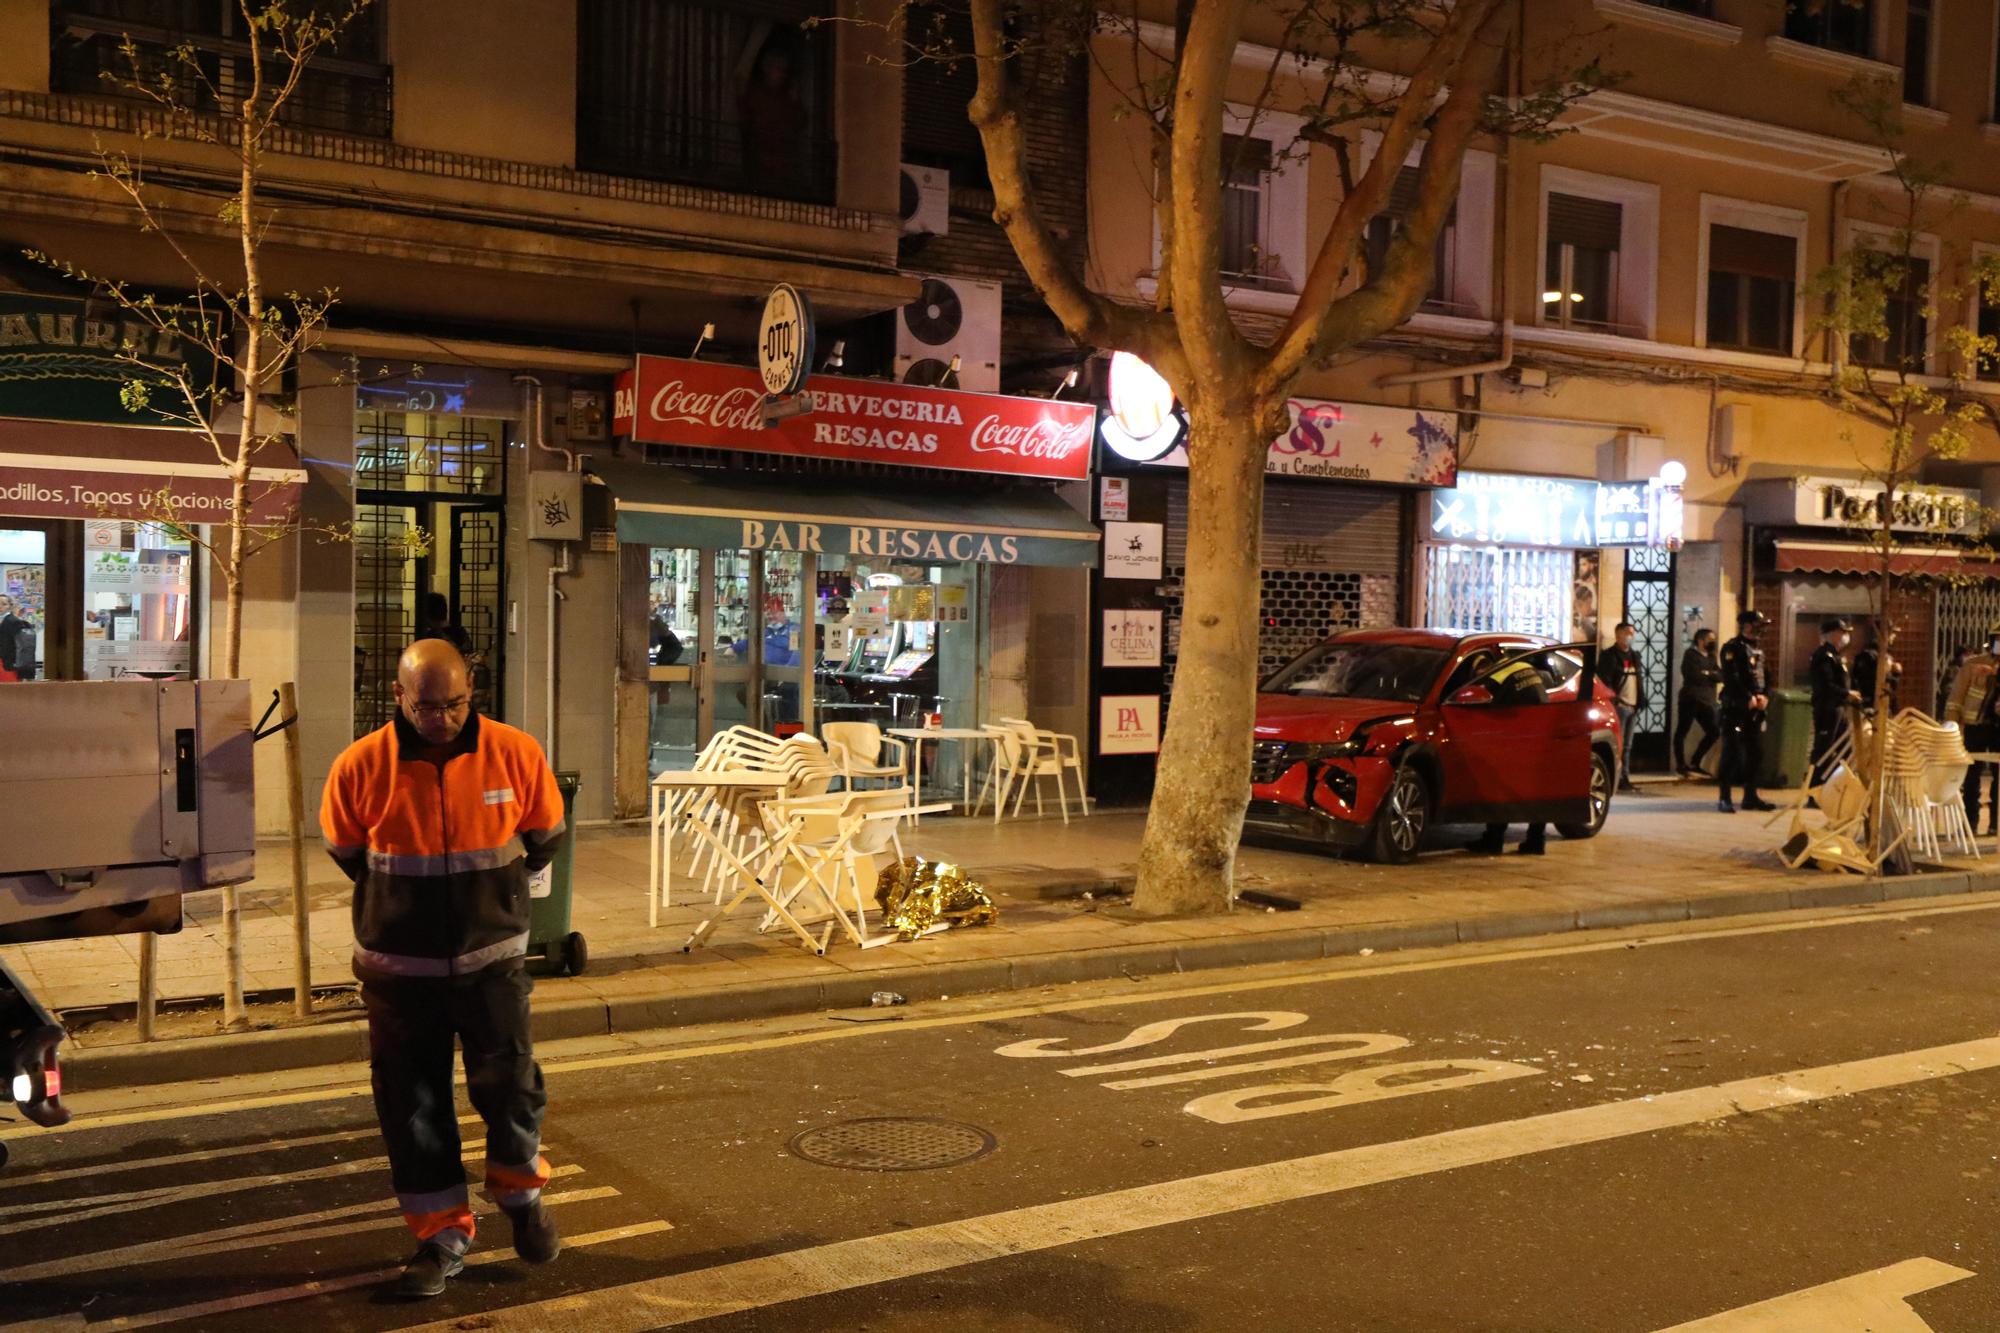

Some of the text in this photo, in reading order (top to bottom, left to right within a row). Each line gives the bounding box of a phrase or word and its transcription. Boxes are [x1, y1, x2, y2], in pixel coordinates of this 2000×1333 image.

[814, 422, 938, 453] RESACAS
[971, 413, 1076, 459] Coca-Cola
[1294, 457, 1370, 479] Complementos
[742, 520, 1018, 563] BAR RESACAS
[1110, 637, 1155, 650] CELINA
[994, 1011, 1548, 1125] BUS
